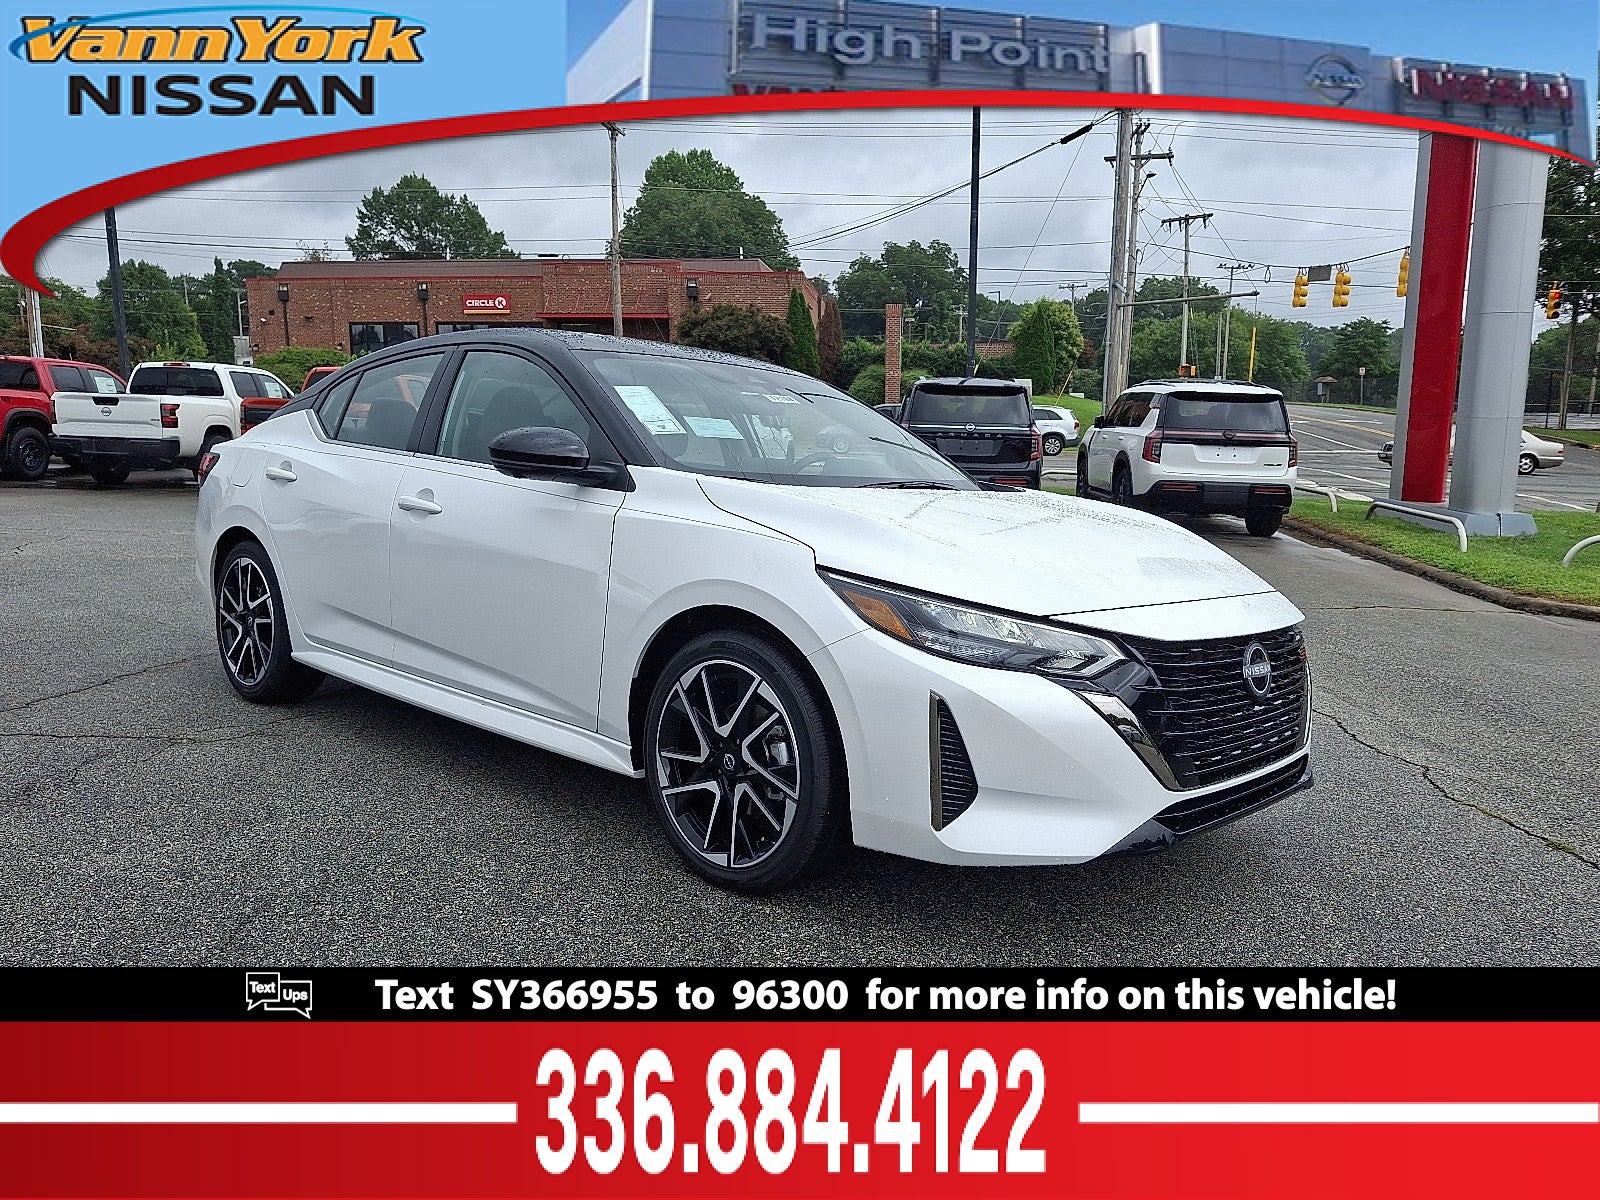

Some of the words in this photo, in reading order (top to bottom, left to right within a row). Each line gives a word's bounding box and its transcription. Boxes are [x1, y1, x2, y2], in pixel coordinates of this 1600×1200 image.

[751, 13, 921, 65] High
[951, 30, 1109, 73] Point
[465, 299, 495, 307] CIRCLE
[496, 298, 506, 308] K
